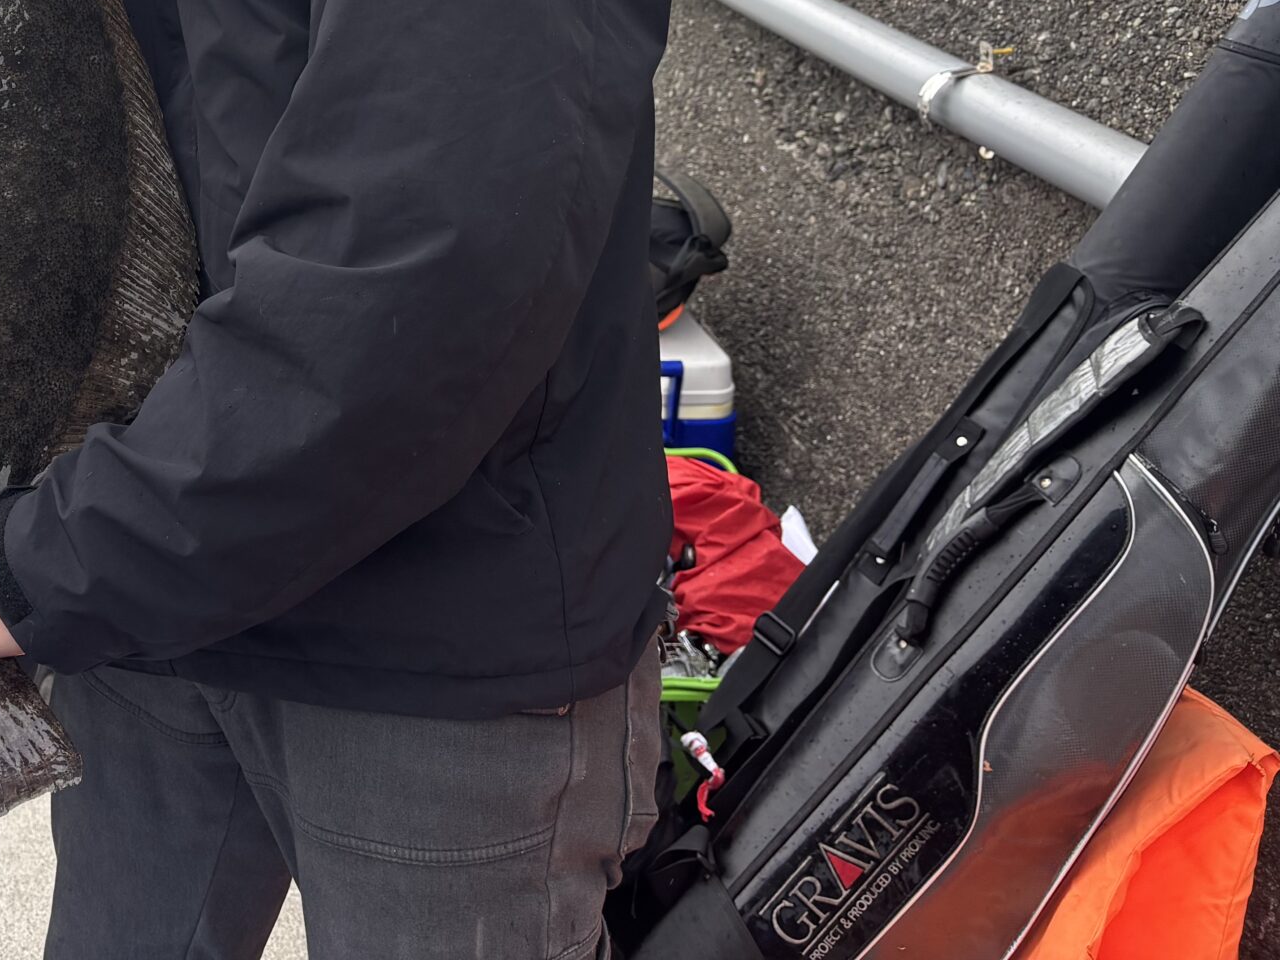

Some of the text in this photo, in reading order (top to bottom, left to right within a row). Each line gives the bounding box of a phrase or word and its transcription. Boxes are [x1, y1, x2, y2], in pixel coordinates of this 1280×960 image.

[772, 783, 920, 945] GRAVIS
[840, 918, 853, 929] &
[847, 873, 892, 921] PRODUCED
[888, 858, 903, 875] BY
